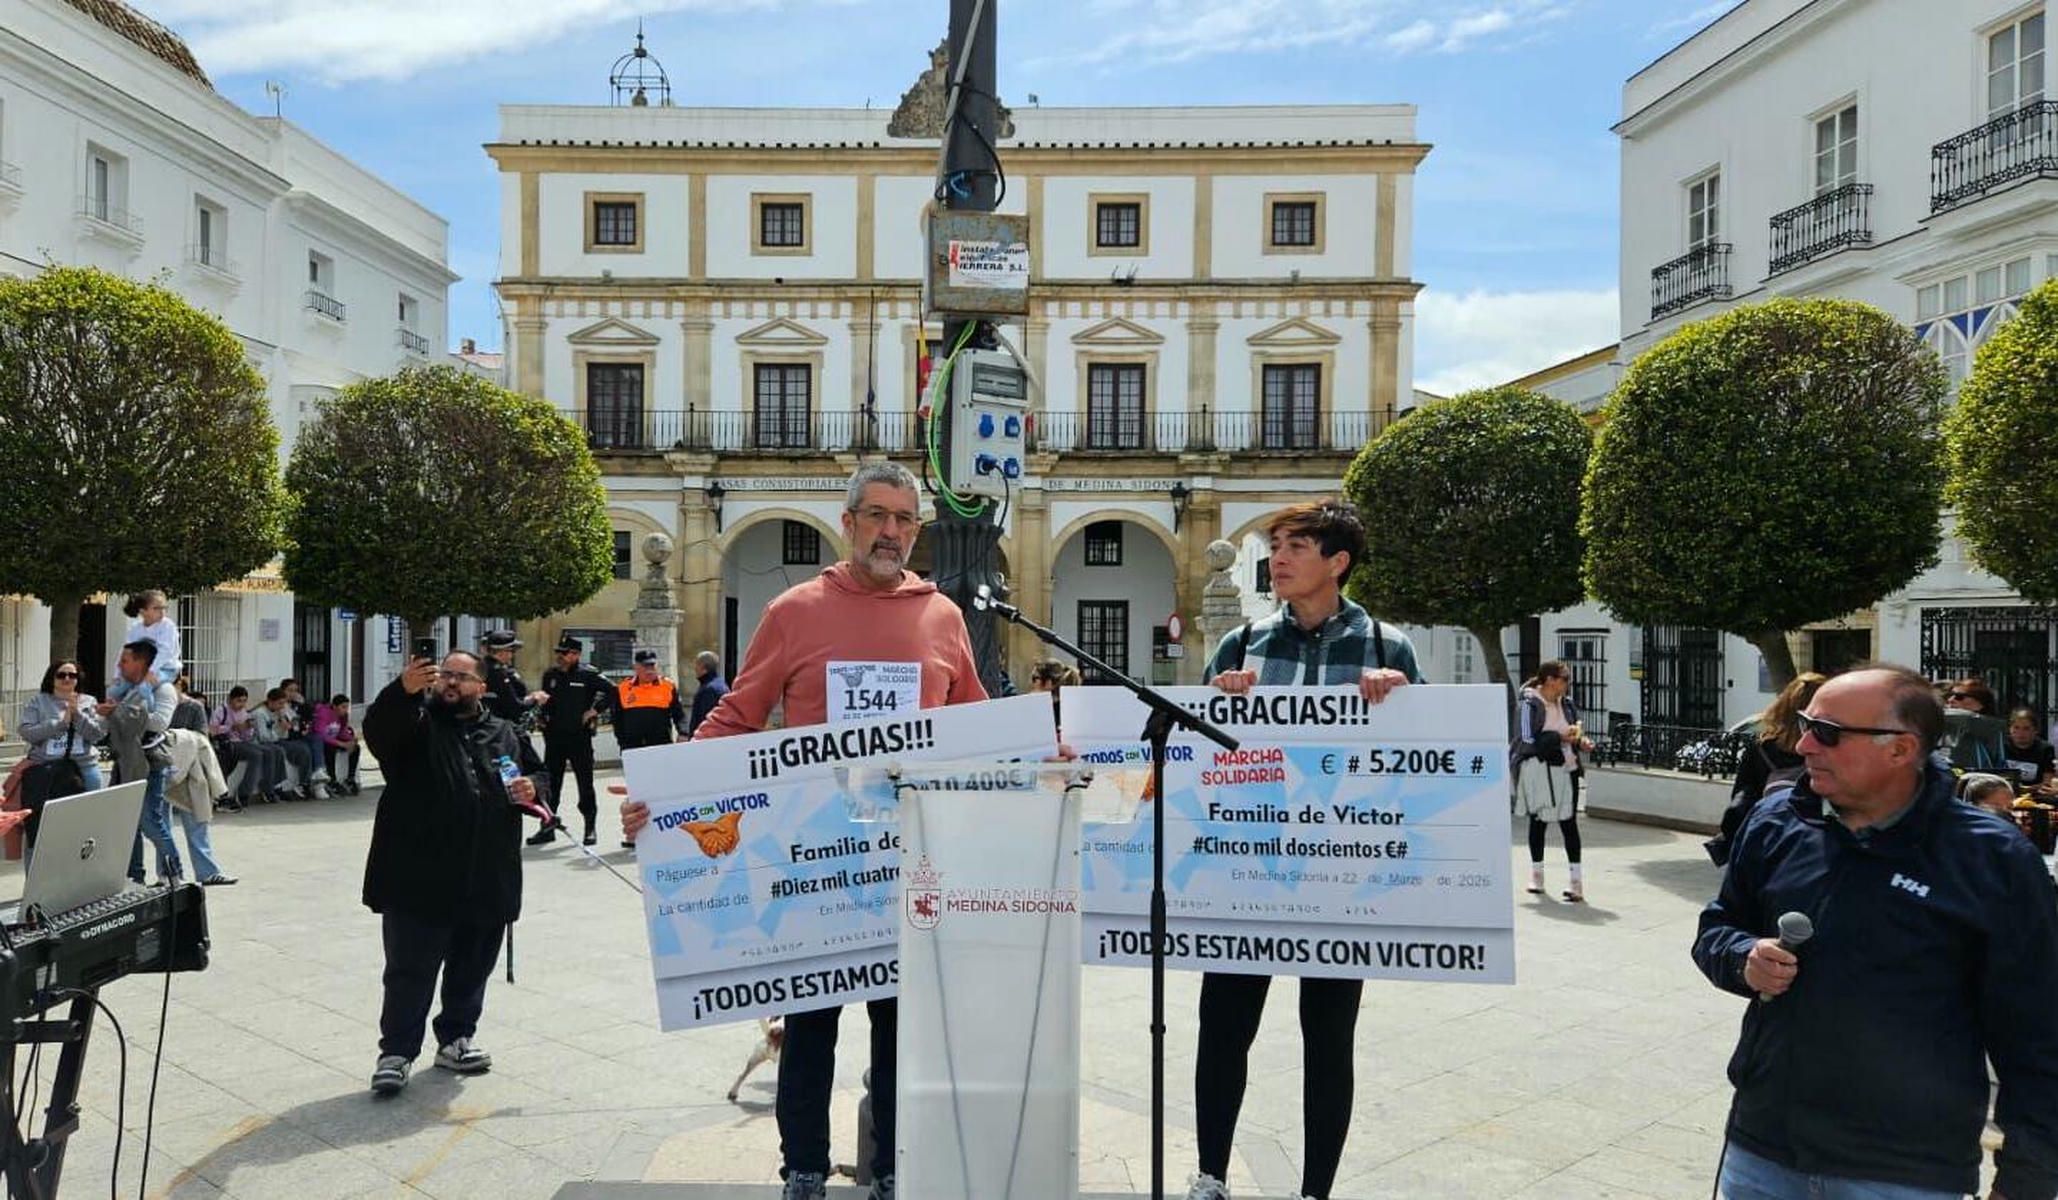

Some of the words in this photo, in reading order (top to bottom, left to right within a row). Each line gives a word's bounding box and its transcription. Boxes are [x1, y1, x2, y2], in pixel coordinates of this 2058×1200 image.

[720, 479, 746, 490] ASAS
[1050, 480, 1064, 490] DE
[1074, 480, 1122, 490] MEDINA
[844, 689, 897, 711] 1544
[749, 719, 934, 779] ¡¡¡GRACIAS!!!
[1141, 745, 1194, 763] VTOR
[1213, 749, 1284, 767] MARCHA
[1370, 749, 1456, 774] 5.200€
[1202, 768, 1286, 785] SOLIDARIA
[652, 807, 699, 832] TODOS
[715, 792, 771, 814] VICTOR
[1208, 803, 1290, 823] Familia
[1299, 805, 1325, 824] de
[1333, 804, 1405, 825] Victor
[790, 836, 870, 863] Familia
[878, 831, 900, 849] de
[1094, 839, 1144, 853] cantidad
[1193, 836, 1249, 855] #Cinco
[1254, 838, 1281, 857] mil
[1285, 838, 1382, 858] doscientos
[656, 866, 708, 883] Páguese
[711, 866, 719, 875] a
[1232, 869, 1245, 880] En
[1248, 870, 1287, 882] Medina
[1289, 871, 1329, 883] Sidonia
[1342, 873, 1357, 884] 22
[770, 878, 819, 899] #Diez
[822, 873, 849, 889] mil
[946, 889, 1078, 900] AYUNTAMIENTO
[659, 901, 675, 916] La
[677, 895, 731, 914] cantidad
[733, 893, 749, 905] de
[947, 900, 1008, 913] MEDINA
[1012, 900, 1077, 913] SIDONIA
[89, 913, 136, 938] DYNACORD
[1195, 934, 1310, 963] ESTAMOS
[1316, 939, 1371, 966] CON
[1376, 942, 1485, 970] VICTOR!
[693, 978, 787, 1020] ¡TODOS
[791, 960, 899, 1000] ESTAMOS
